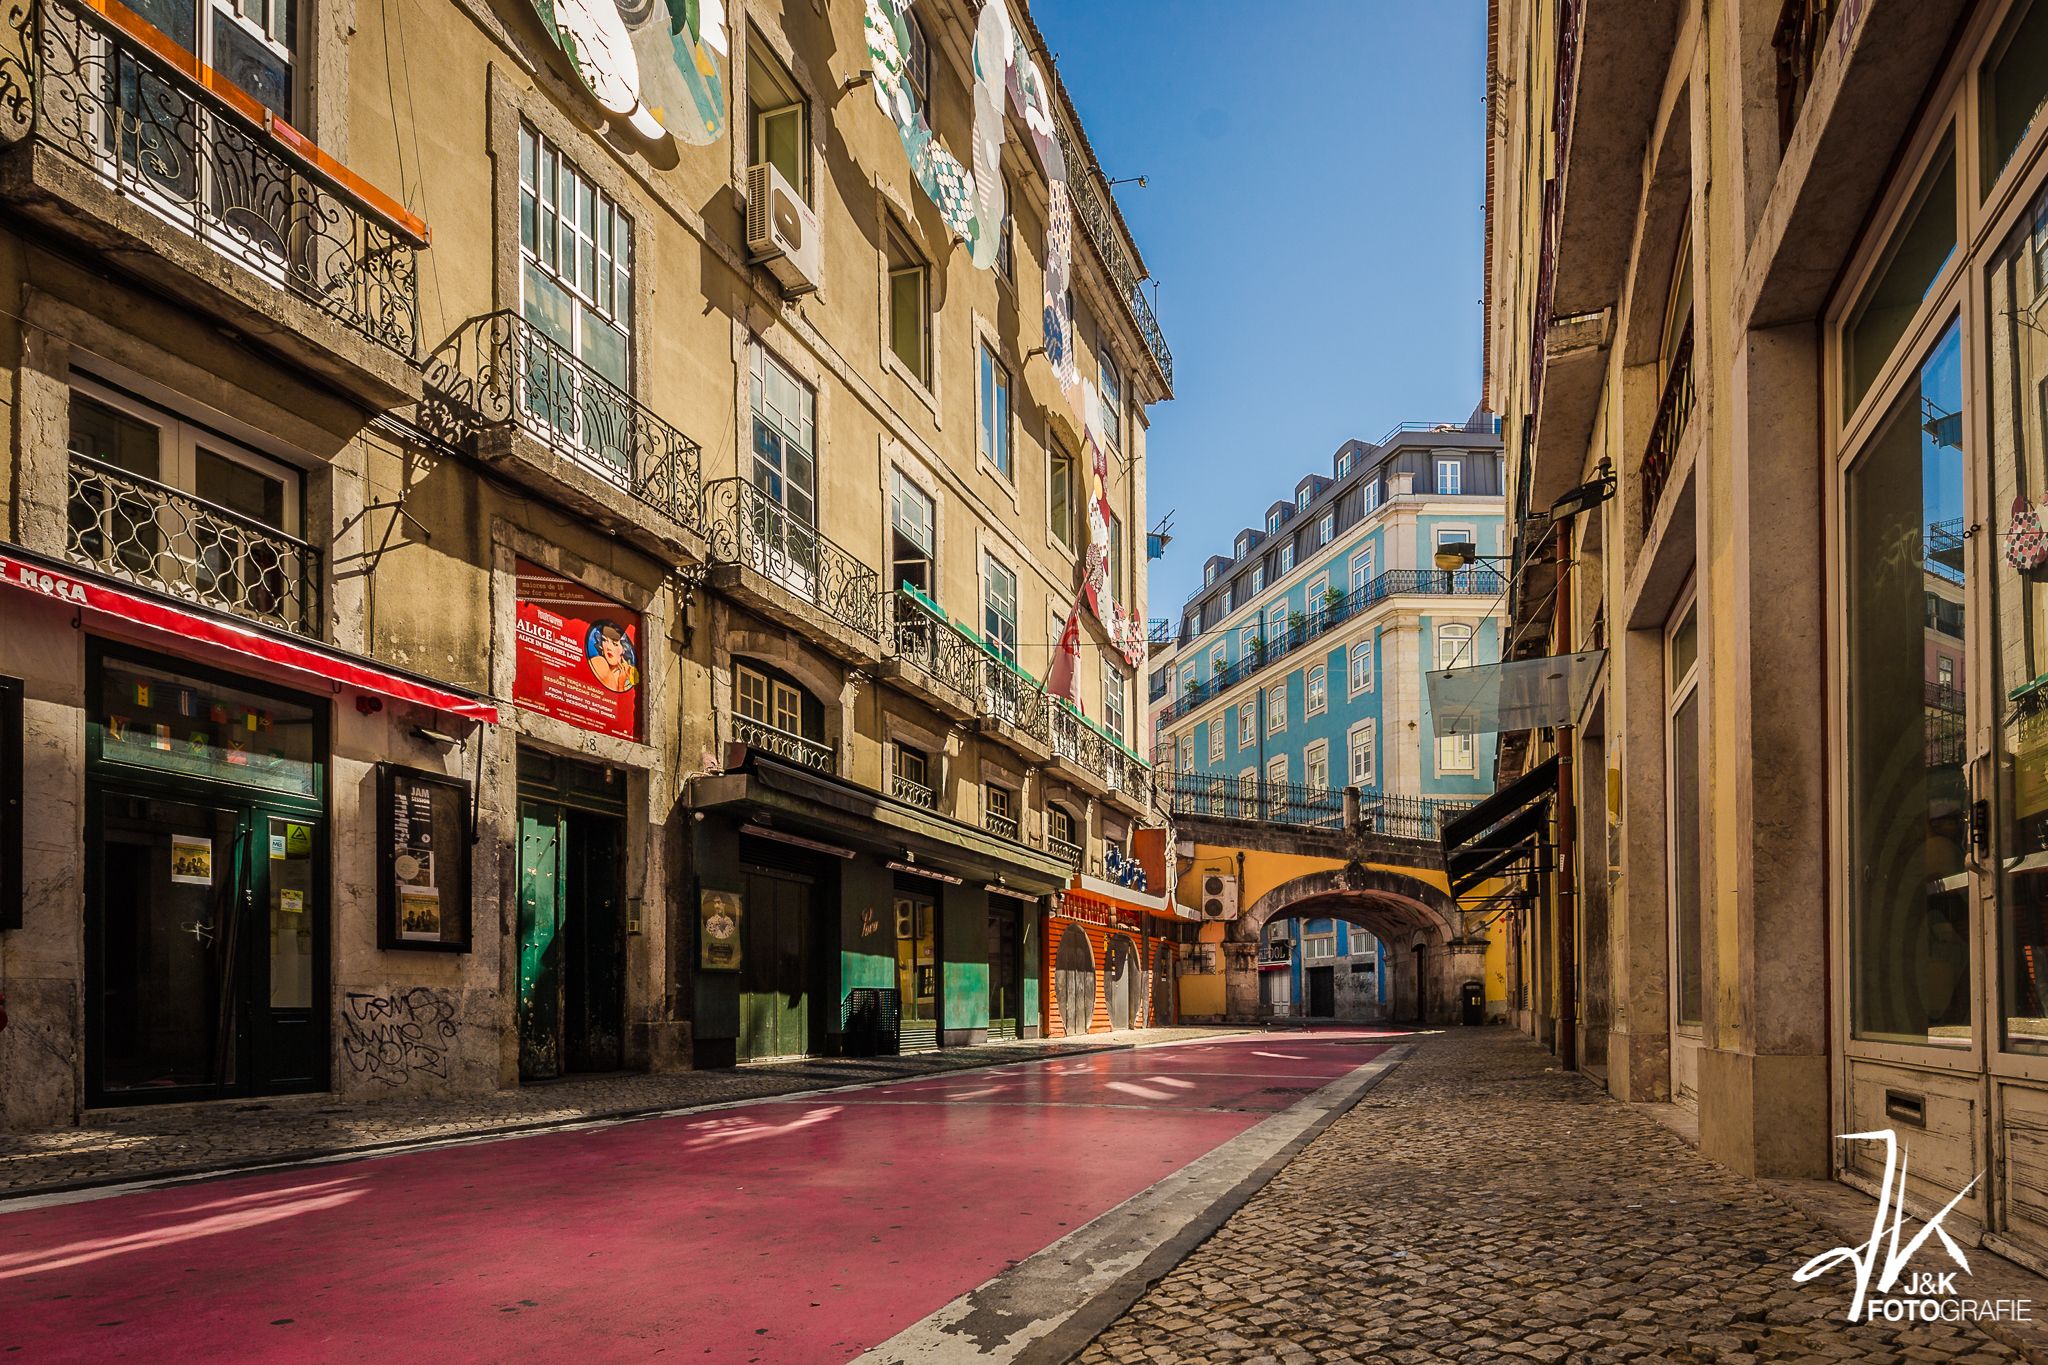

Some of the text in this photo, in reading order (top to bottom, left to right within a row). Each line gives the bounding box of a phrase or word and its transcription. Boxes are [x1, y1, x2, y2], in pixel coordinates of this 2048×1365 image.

[20, 567, 87, 603] MOÇA
[517, 618, 553, 641] ALICE
[518, 633, 535, 645] ALICE
[535, 640, 542, 648] IN
[542, 642, 567, 657] BROTHEL
[566, 652, 581, 662] LAND
[543, 675, 566, 687] SESSÕES
[544, 690, 566, 702] SPECIAL
[565, 697, 589, 710] SESSIONS
[588, 706, 600, 714] WITH
[600, 709, 616, 720] DINNER
[548, 686, 563, 695] FROM
[563, 691, 584, 702] TUESDAY
[410, 786, 430, 798] JAM
